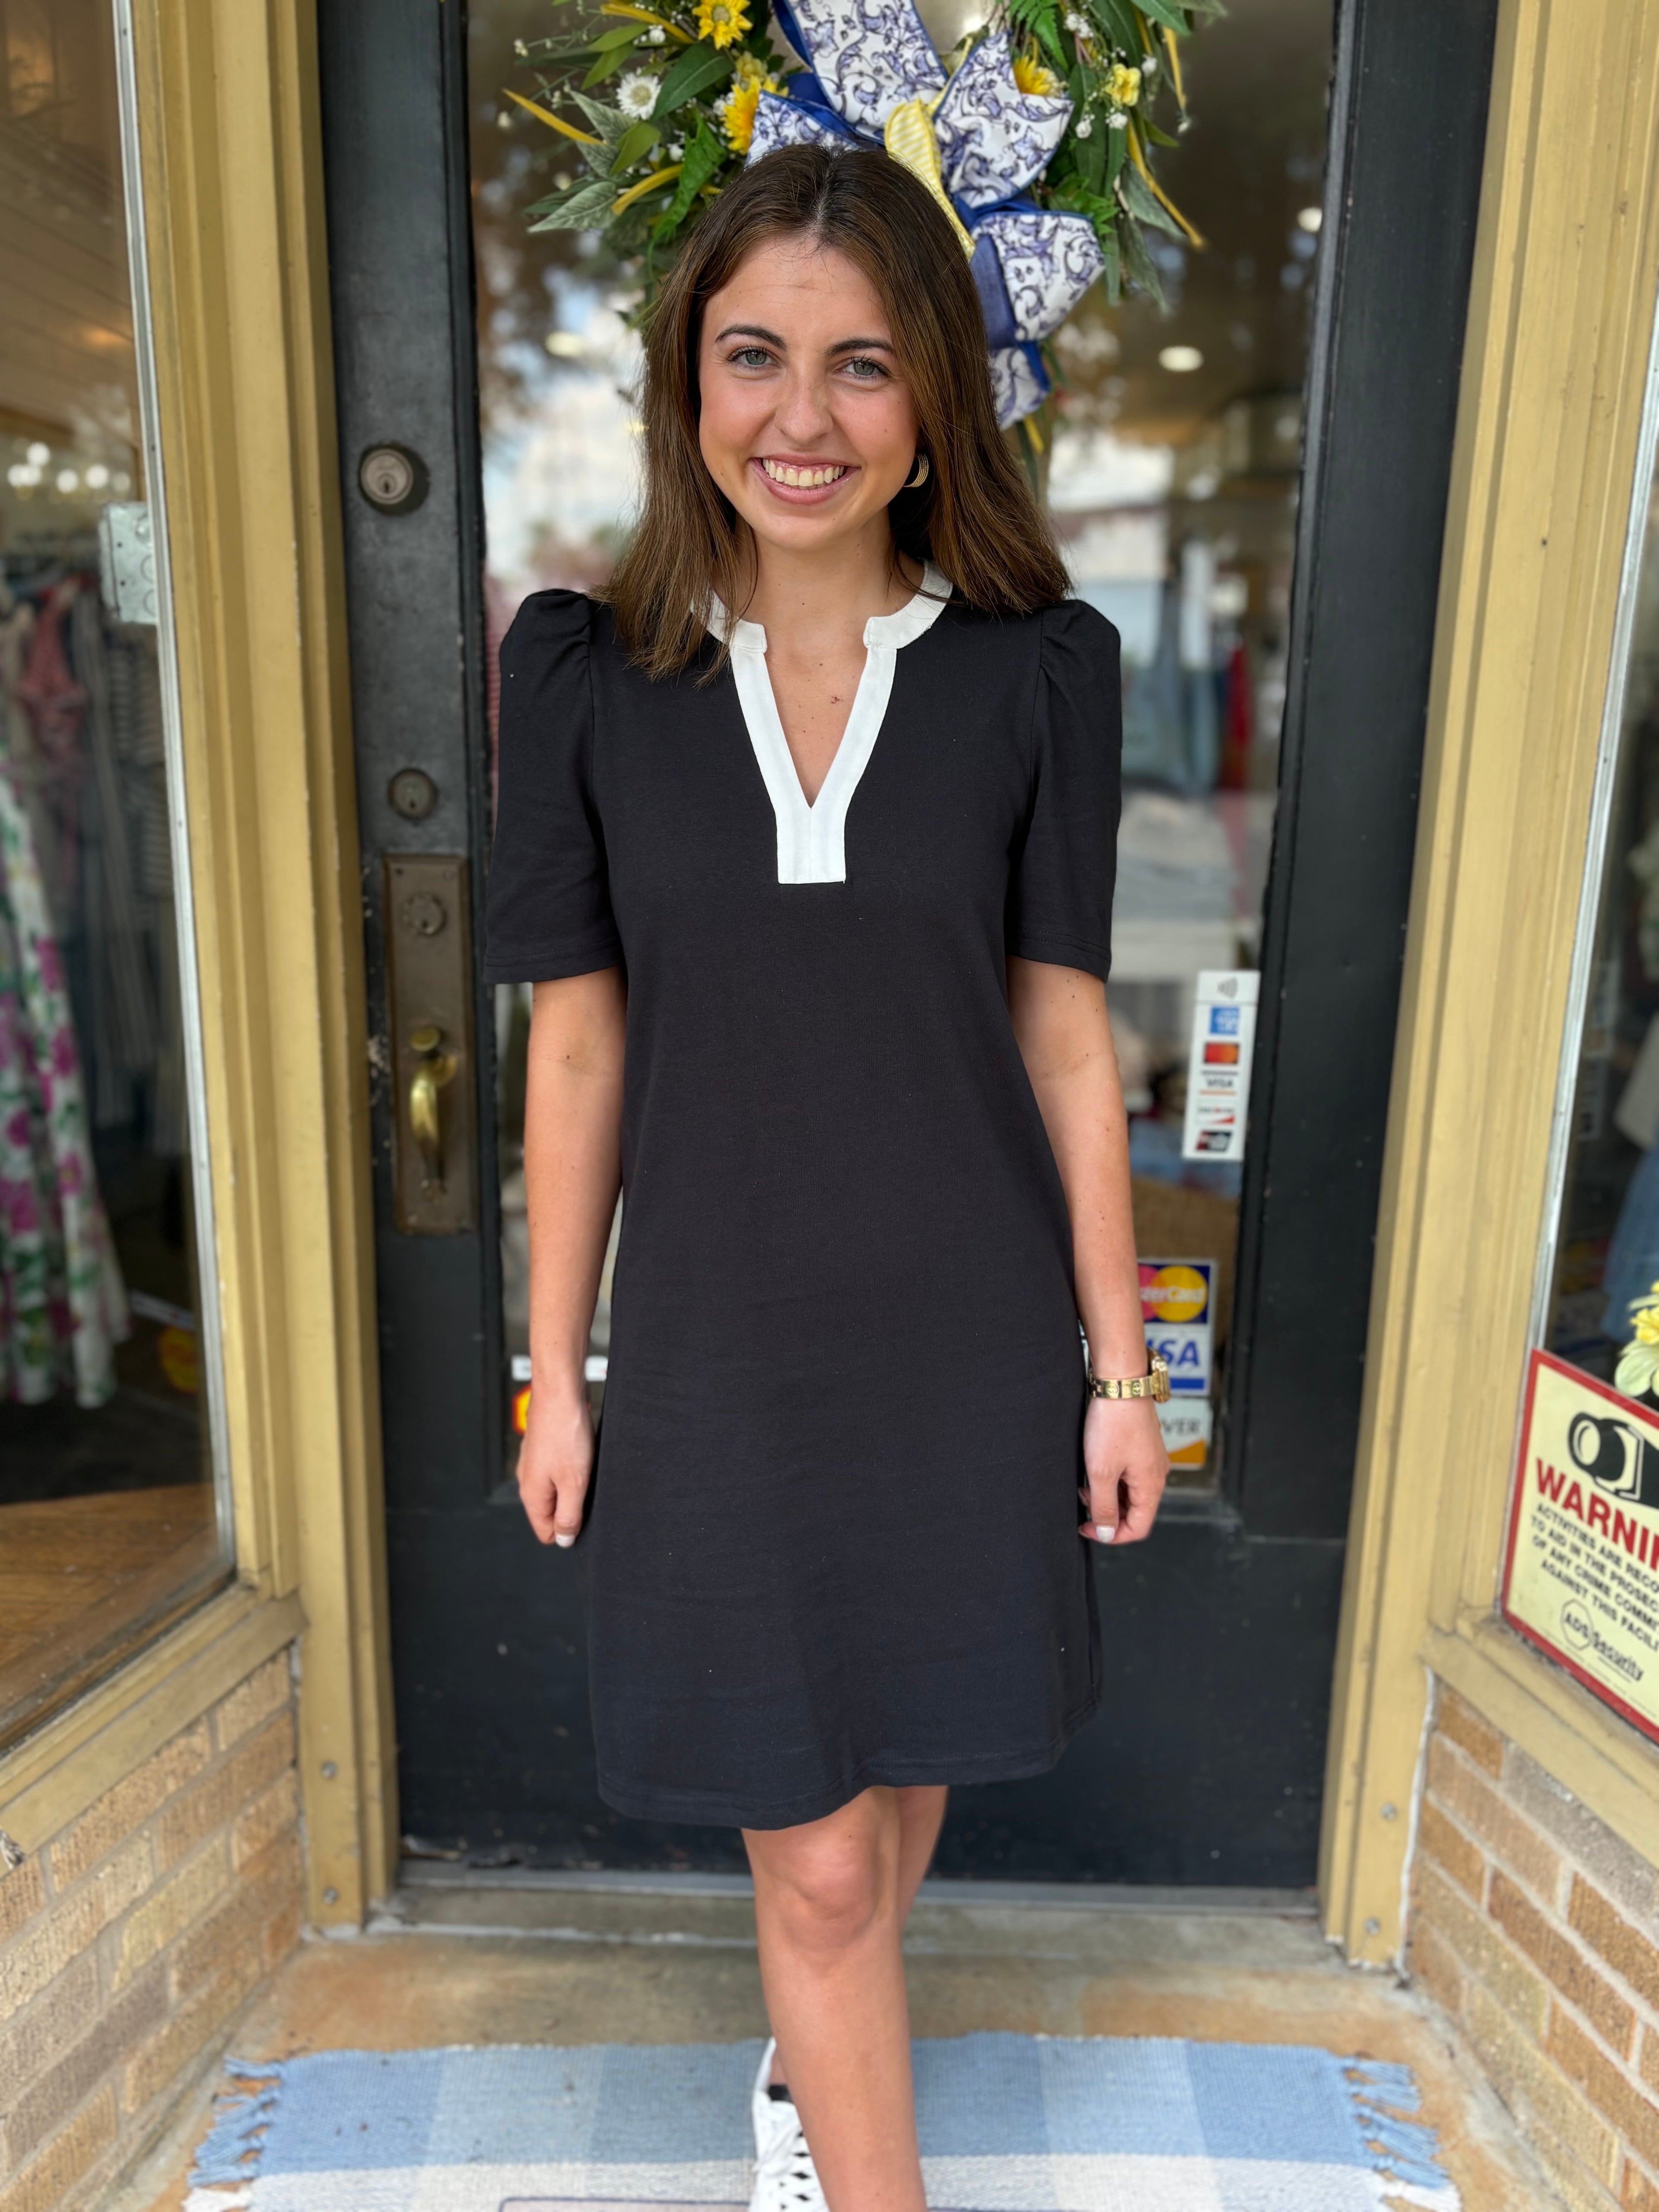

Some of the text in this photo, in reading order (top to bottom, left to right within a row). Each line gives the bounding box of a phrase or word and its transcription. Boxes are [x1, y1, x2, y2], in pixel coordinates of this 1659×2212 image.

[1146, 1339, 1199, 1366] SA
[1532, 1515, 1545, 1532] TO
[1549, 1529, 1566, 1547] AID
[1586, 1552, 1606, 1576] THE
[1599, 1545, 1621, 1567] ARE
[1575, 1564, 1611, 1597] CRIME
[1615, 1593, 1659, 1632] COMMI
[1592, 1593, 1617, 1621] THIS
